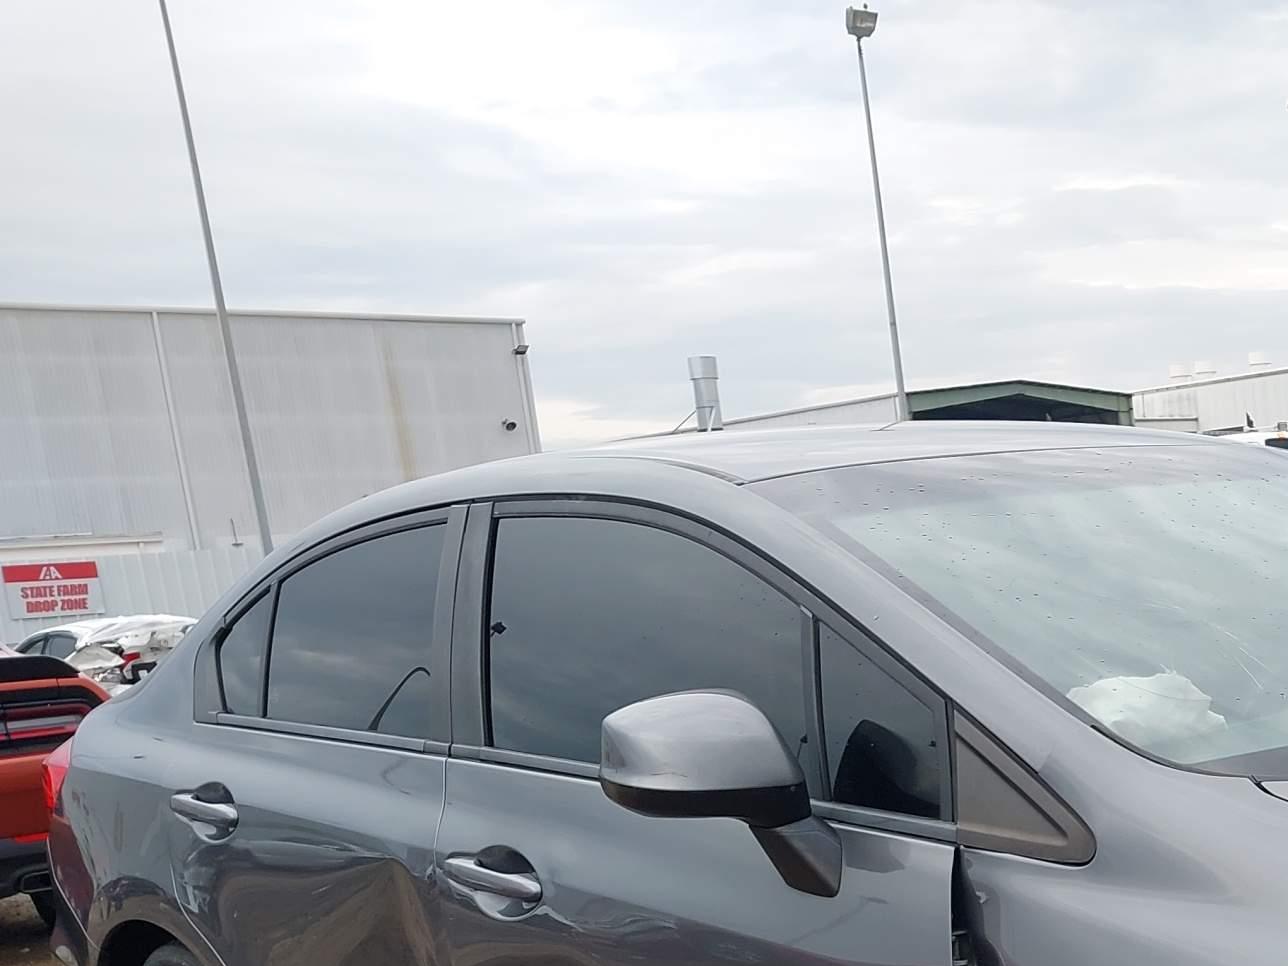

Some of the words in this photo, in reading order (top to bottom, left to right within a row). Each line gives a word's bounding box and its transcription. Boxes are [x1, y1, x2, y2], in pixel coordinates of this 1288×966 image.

[21, 585, 55, 599] STATE
[57, 583, 88, 597] FARM
[26, 599, 58, 613] DROP
[60, 598, 88, 611] ZONE
